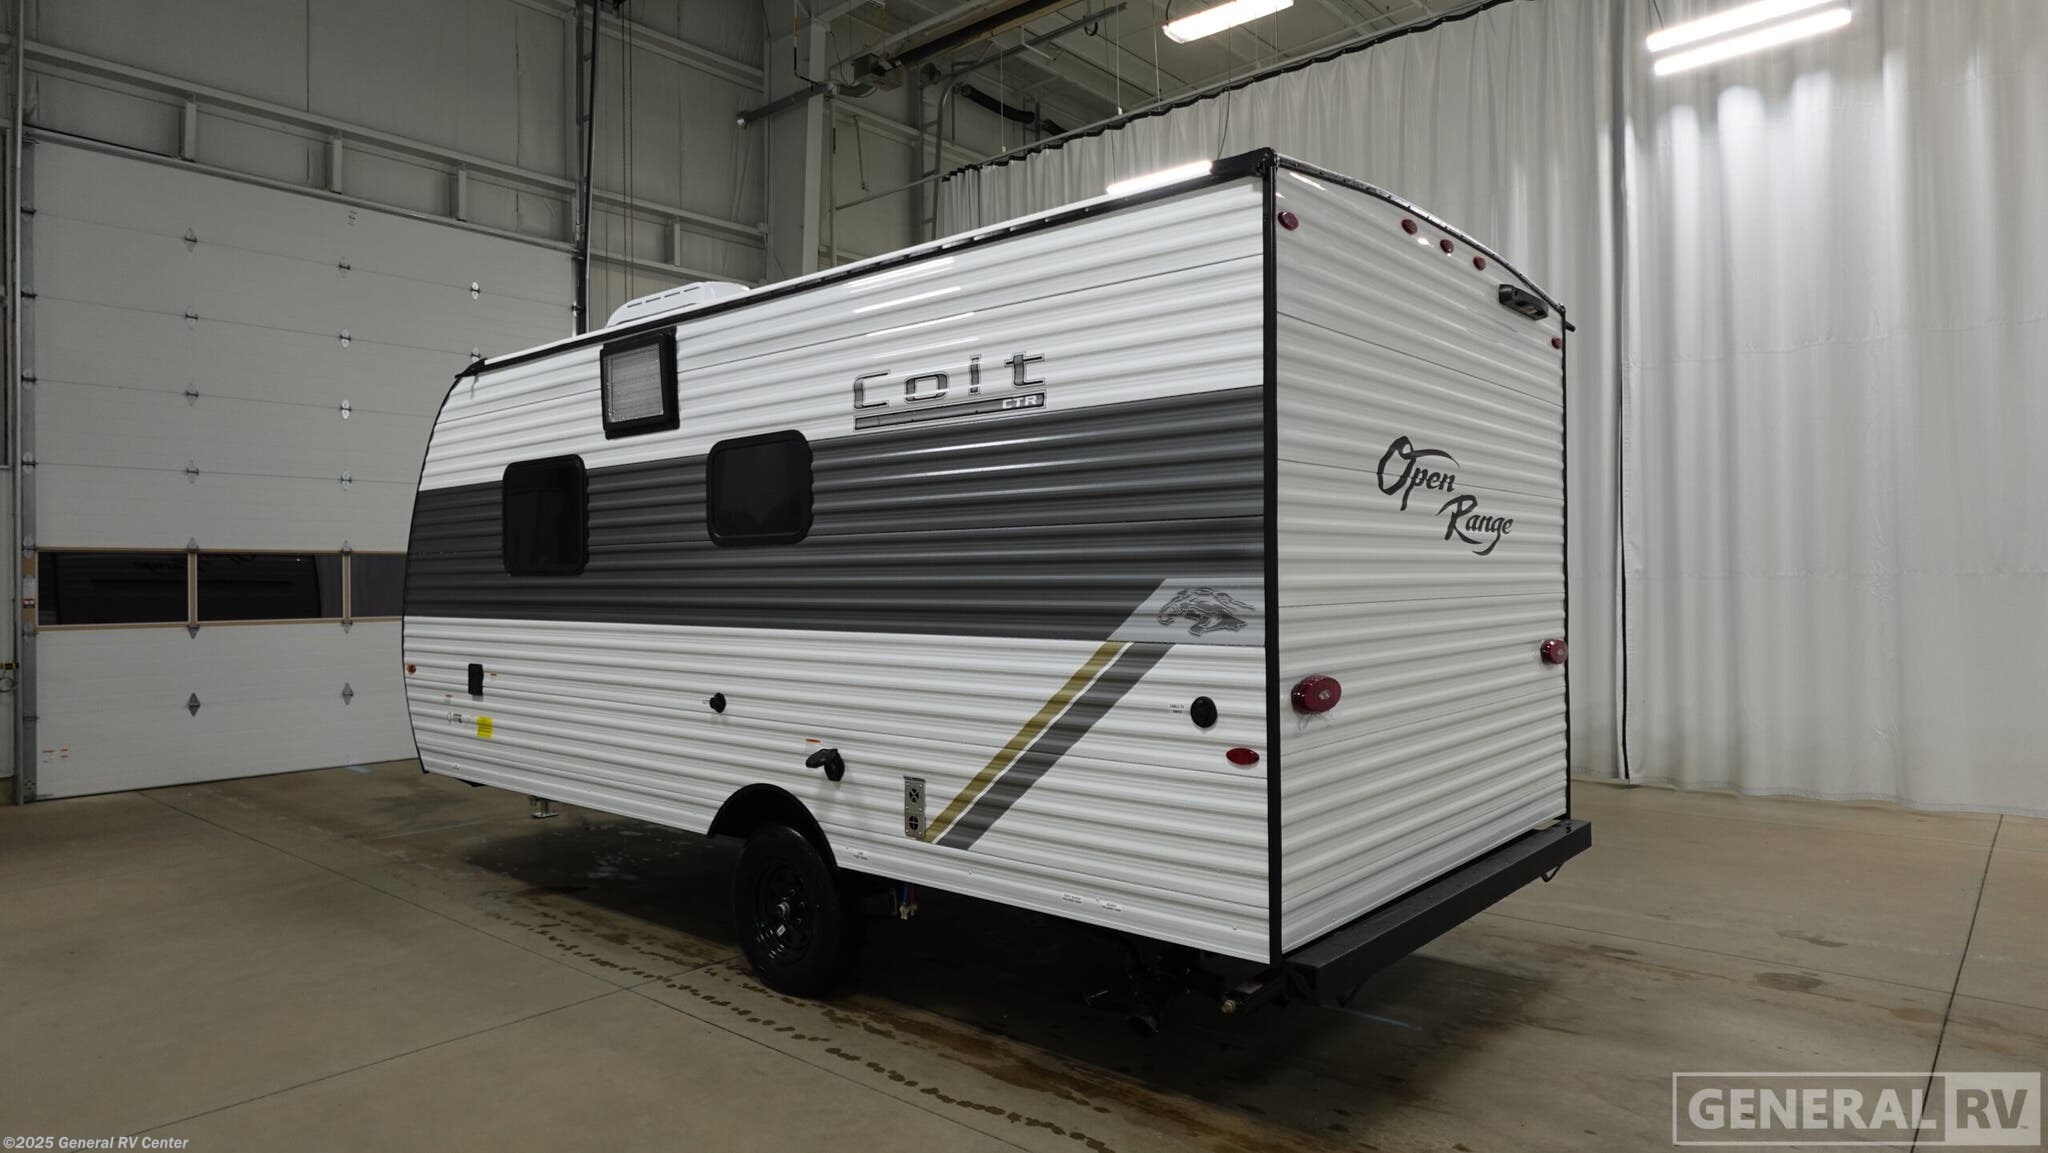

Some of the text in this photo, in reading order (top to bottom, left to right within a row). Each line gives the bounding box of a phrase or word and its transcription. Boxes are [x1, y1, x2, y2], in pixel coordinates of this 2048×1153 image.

[853, 351, 1046, 410] Colt
[1001, 394, 1039, 410] CTR
[1376, 435, 1461, 511] Open
[1435, 494, 1514, 556] Range
